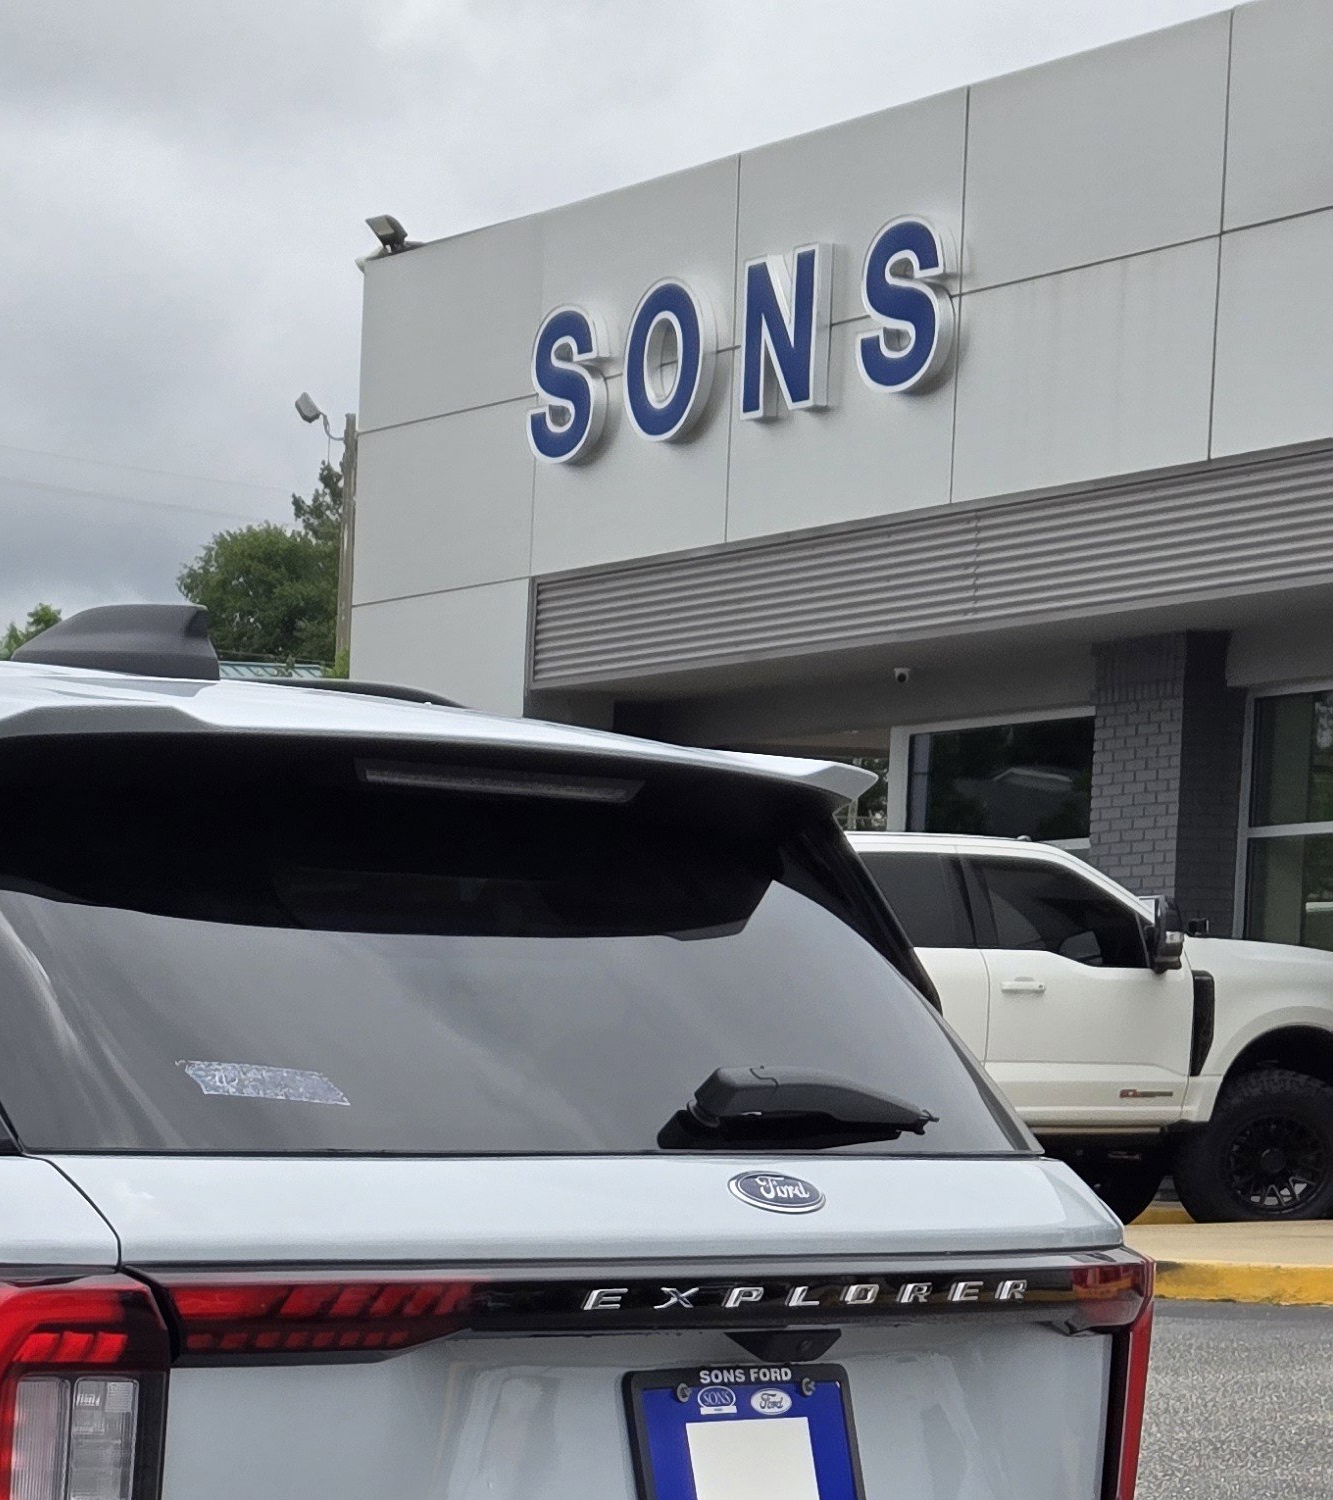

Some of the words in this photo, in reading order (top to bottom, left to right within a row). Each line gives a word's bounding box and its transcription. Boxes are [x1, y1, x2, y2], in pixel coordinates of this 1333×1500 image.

[527, 214, 954, 464] SONS
[754, 1175, 810, 1199] Ford
[580, 1278, 1029, 1311] EXPLORER
[699, 1369, 745, 1384] SONS
[750, 1367, 792, 1382] FORD
[759, 1392, 784, 1410] Ford
